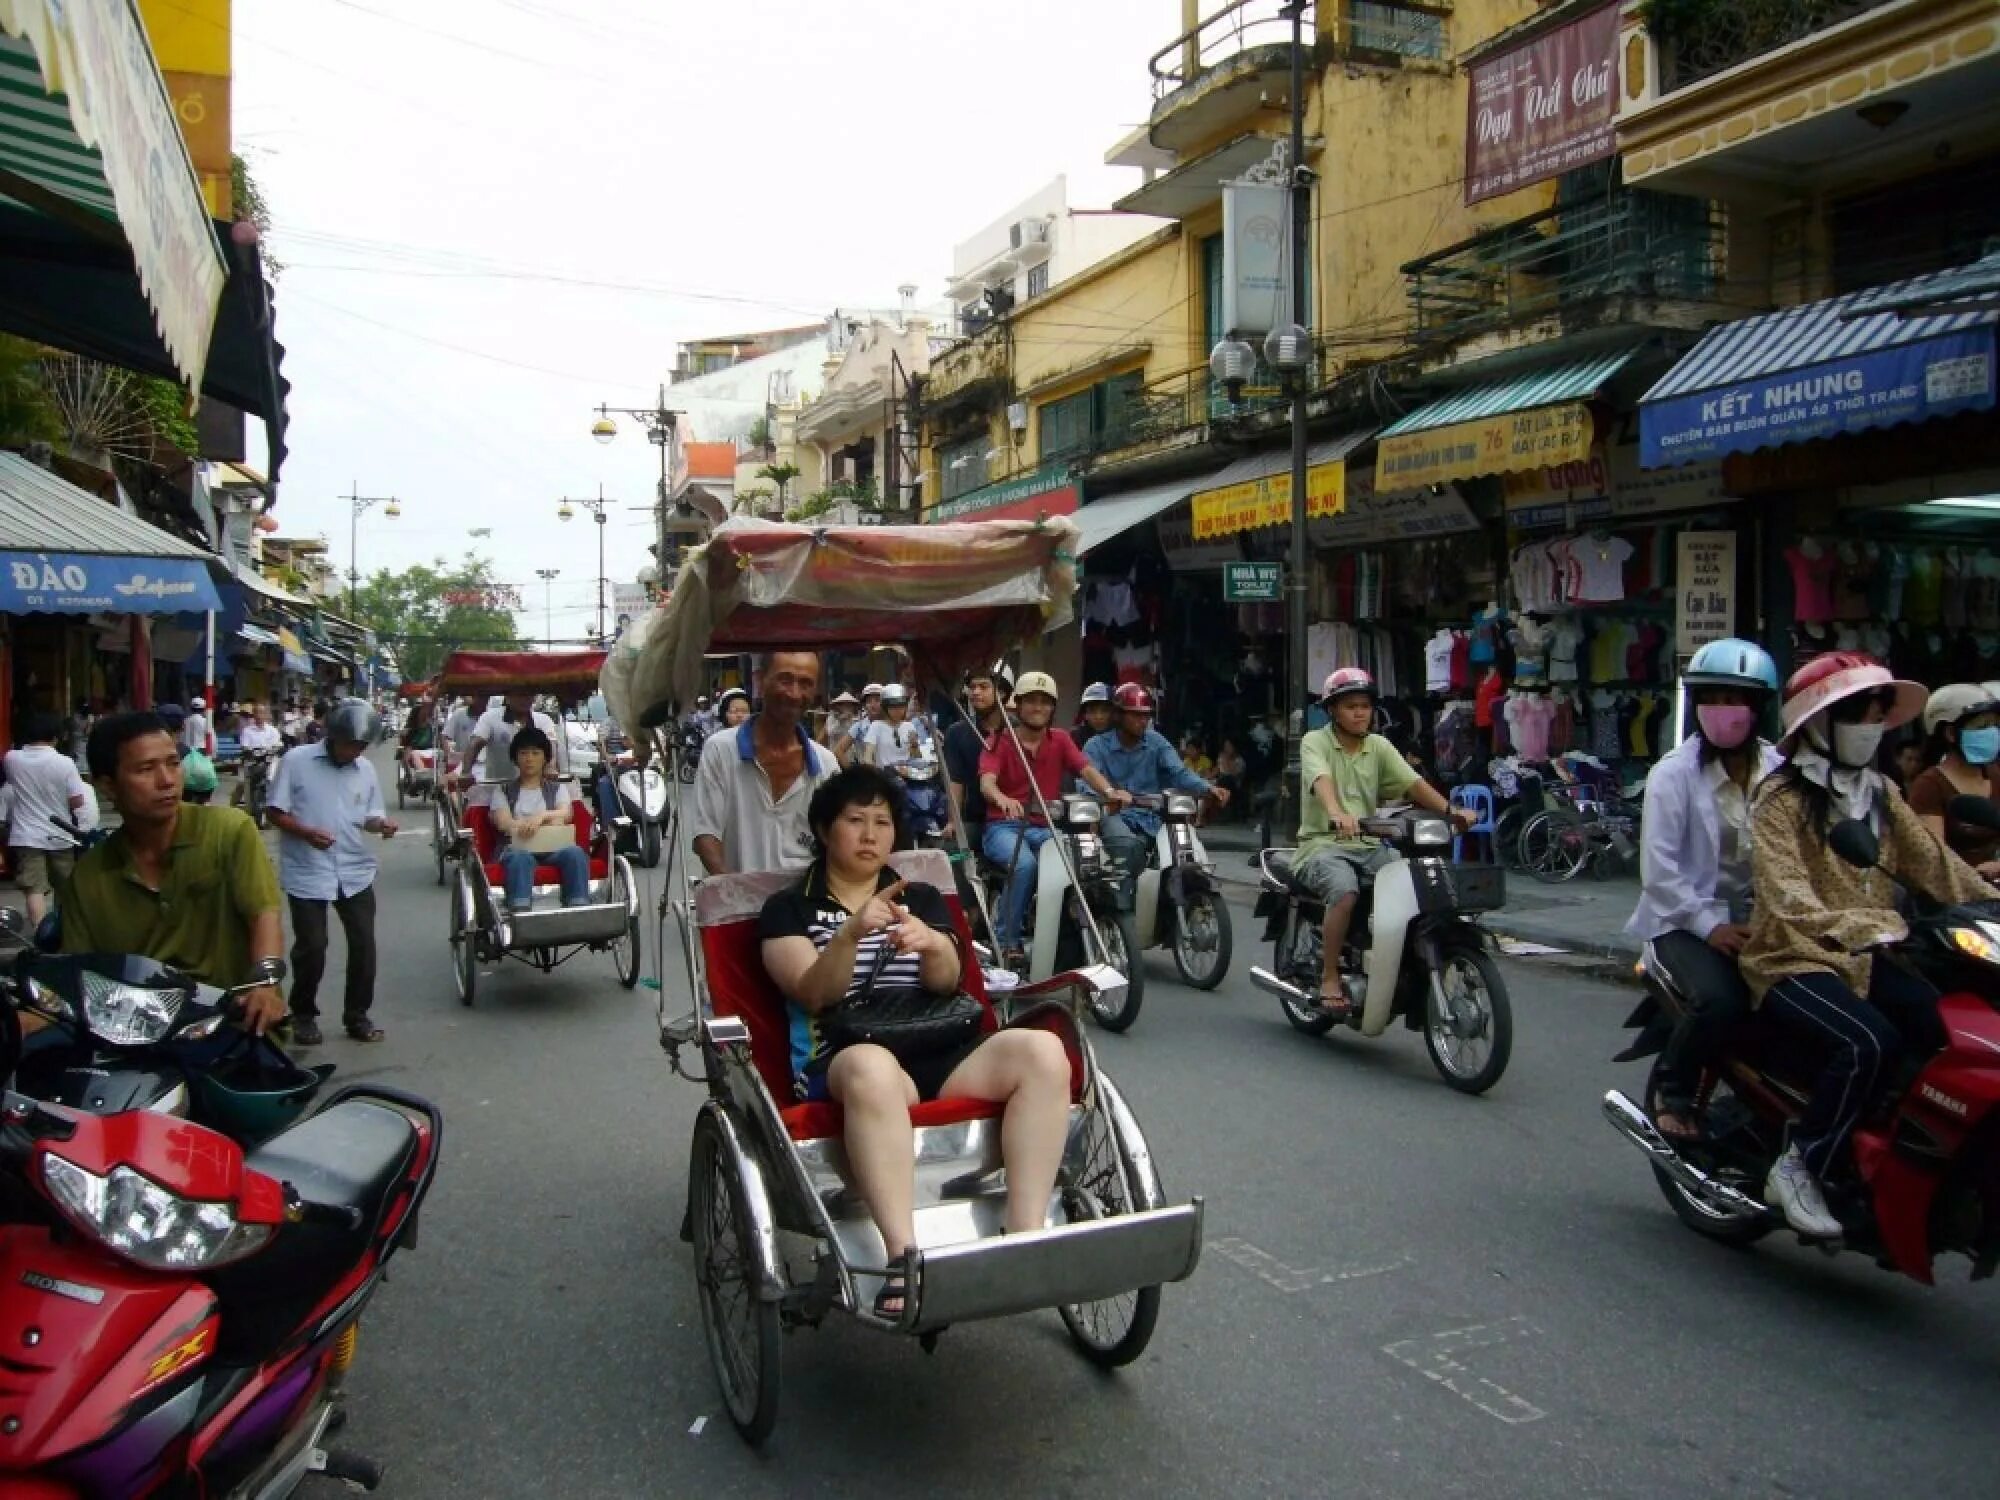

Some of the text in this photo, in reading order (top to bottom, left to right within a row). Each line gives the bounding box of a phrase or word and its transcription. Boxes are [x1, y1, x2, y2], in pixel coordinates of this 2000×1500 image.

[1702, 370, 1863, 423] KẾT NHUNG
[1921, 1082, 1968, 1117] YAMAHA
